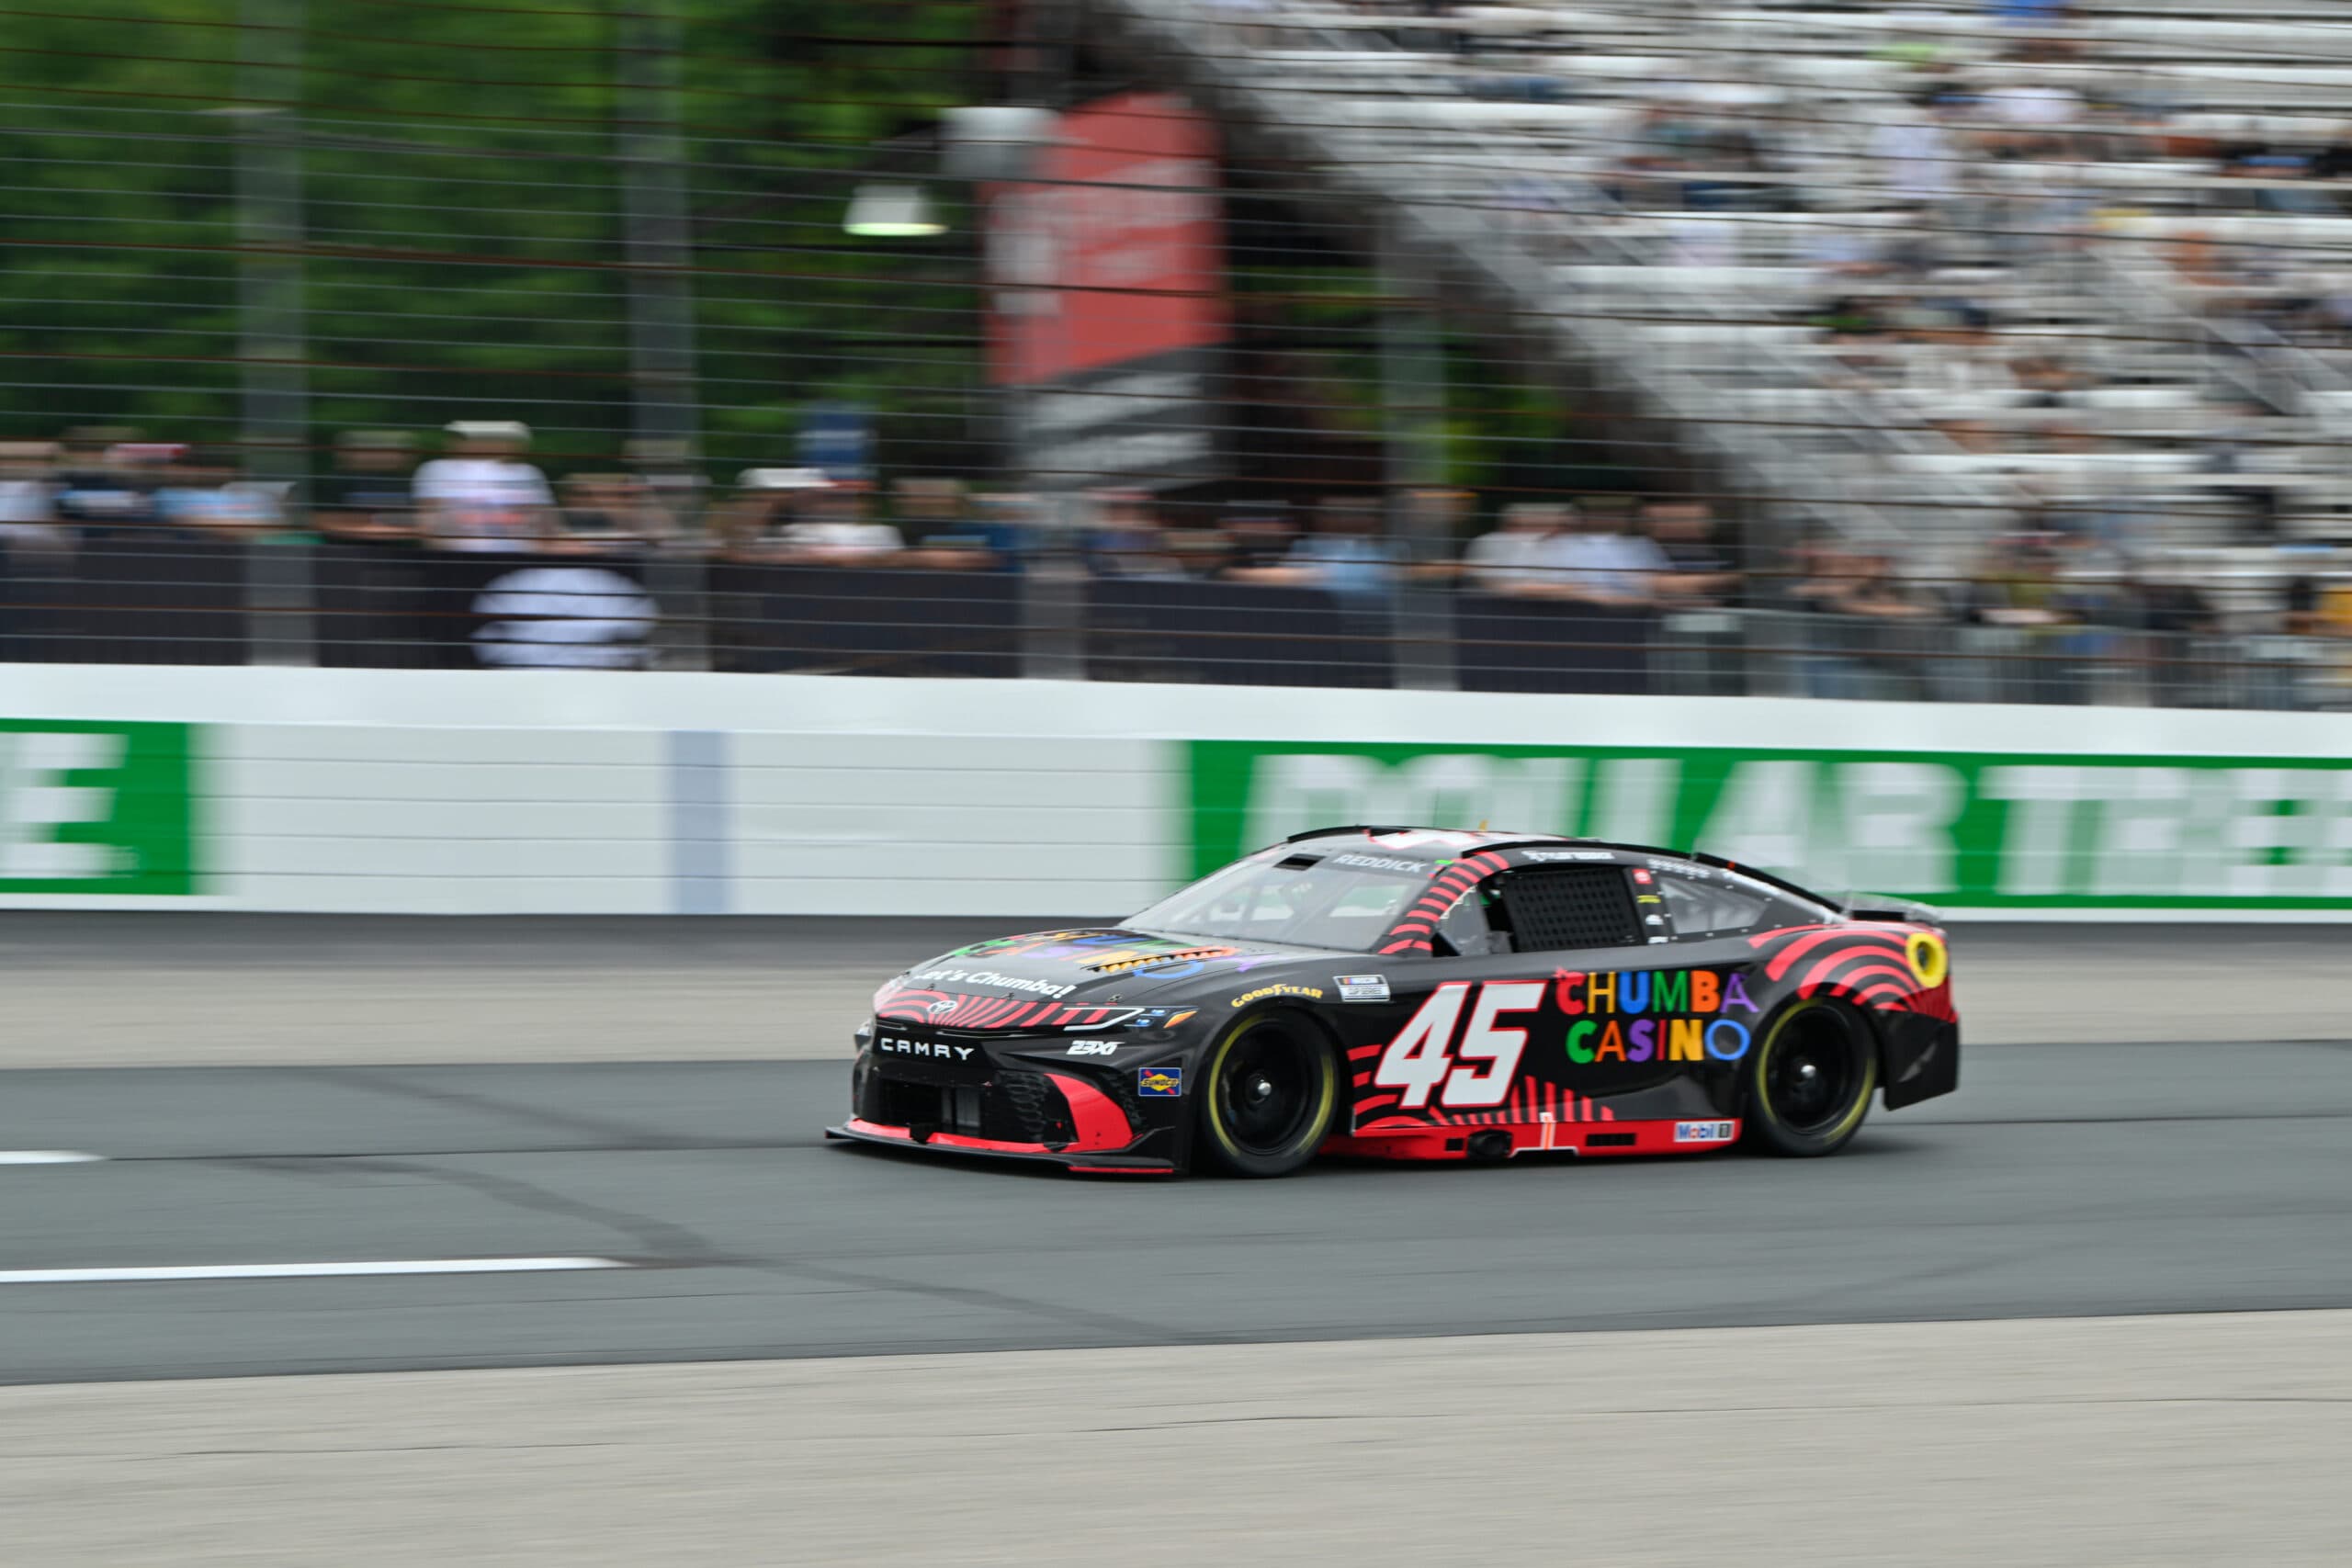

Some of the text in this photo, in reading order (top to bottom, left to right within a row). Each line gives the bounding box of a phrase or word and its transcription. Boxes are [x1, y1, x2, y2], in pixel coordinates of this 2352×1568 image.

[1333, 854, 1428, 873] REDDICK
[966, 971, 1077, 999] Chumba!
[1231, 983, 1323, 1008] GOODYEAR
[1555, 970, 1759, 1015] CHUMBA
[879, 1037, 975, 1060] CAMRY
[1374, 980, 1549, 1110] 45
[1565, 1019, 1751, 1064] CASINO
[1140, 1077, 1180, 1088] SUNOCO
[1678, 1123, 1714, 1139] Mobil
